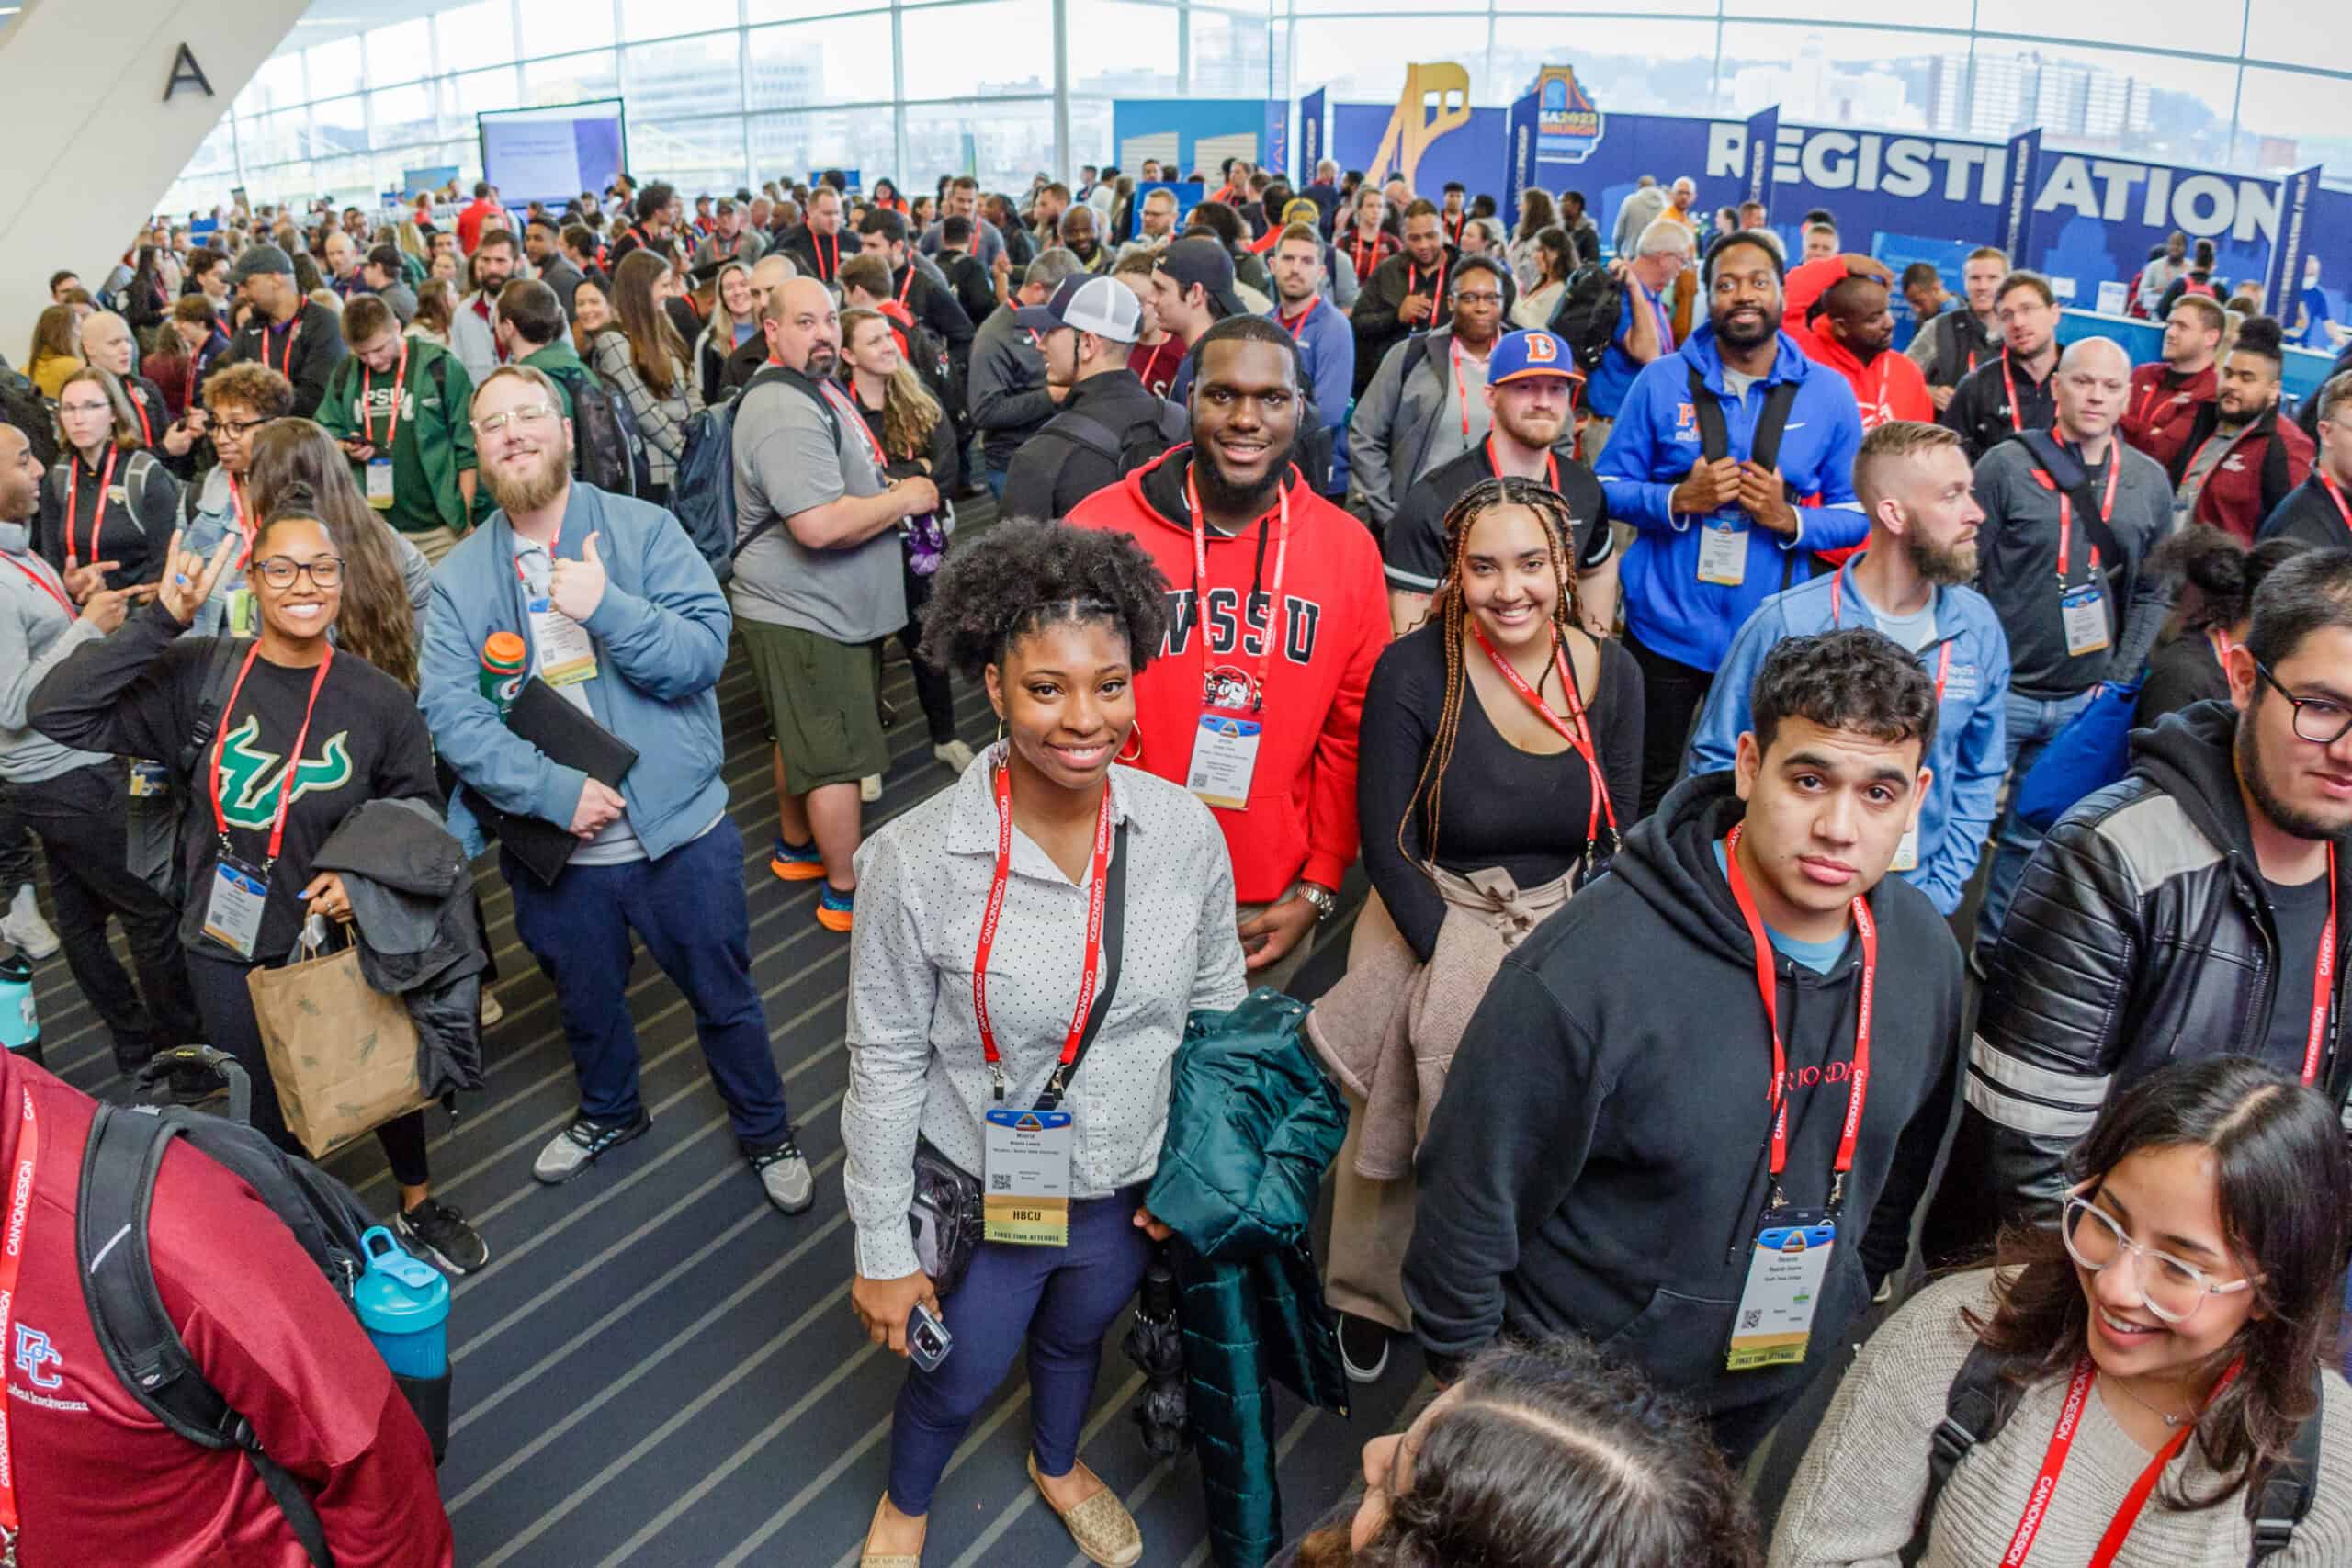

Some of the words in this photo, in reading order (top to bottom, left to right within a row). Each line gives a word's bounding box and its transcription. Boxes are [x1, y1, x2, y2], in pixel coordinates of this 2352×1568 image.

[162, 41, 215, 102] A
[982, 878, 1004, 944] CANNONDESIGN
[1089, 878, 1103, 943] CANNONDESIGN
[1073, 969, 1094, 1034] CANNONDESIGN
[1844, 1068, 1864, 1137] CANNONDESIGN
[7, 1160, 33, 1257] CANNONDESIGN
[1012, 1210, 1042, 1221] HBCU
[2006, 1475, 2053, 1567] CANNONDESIGN
